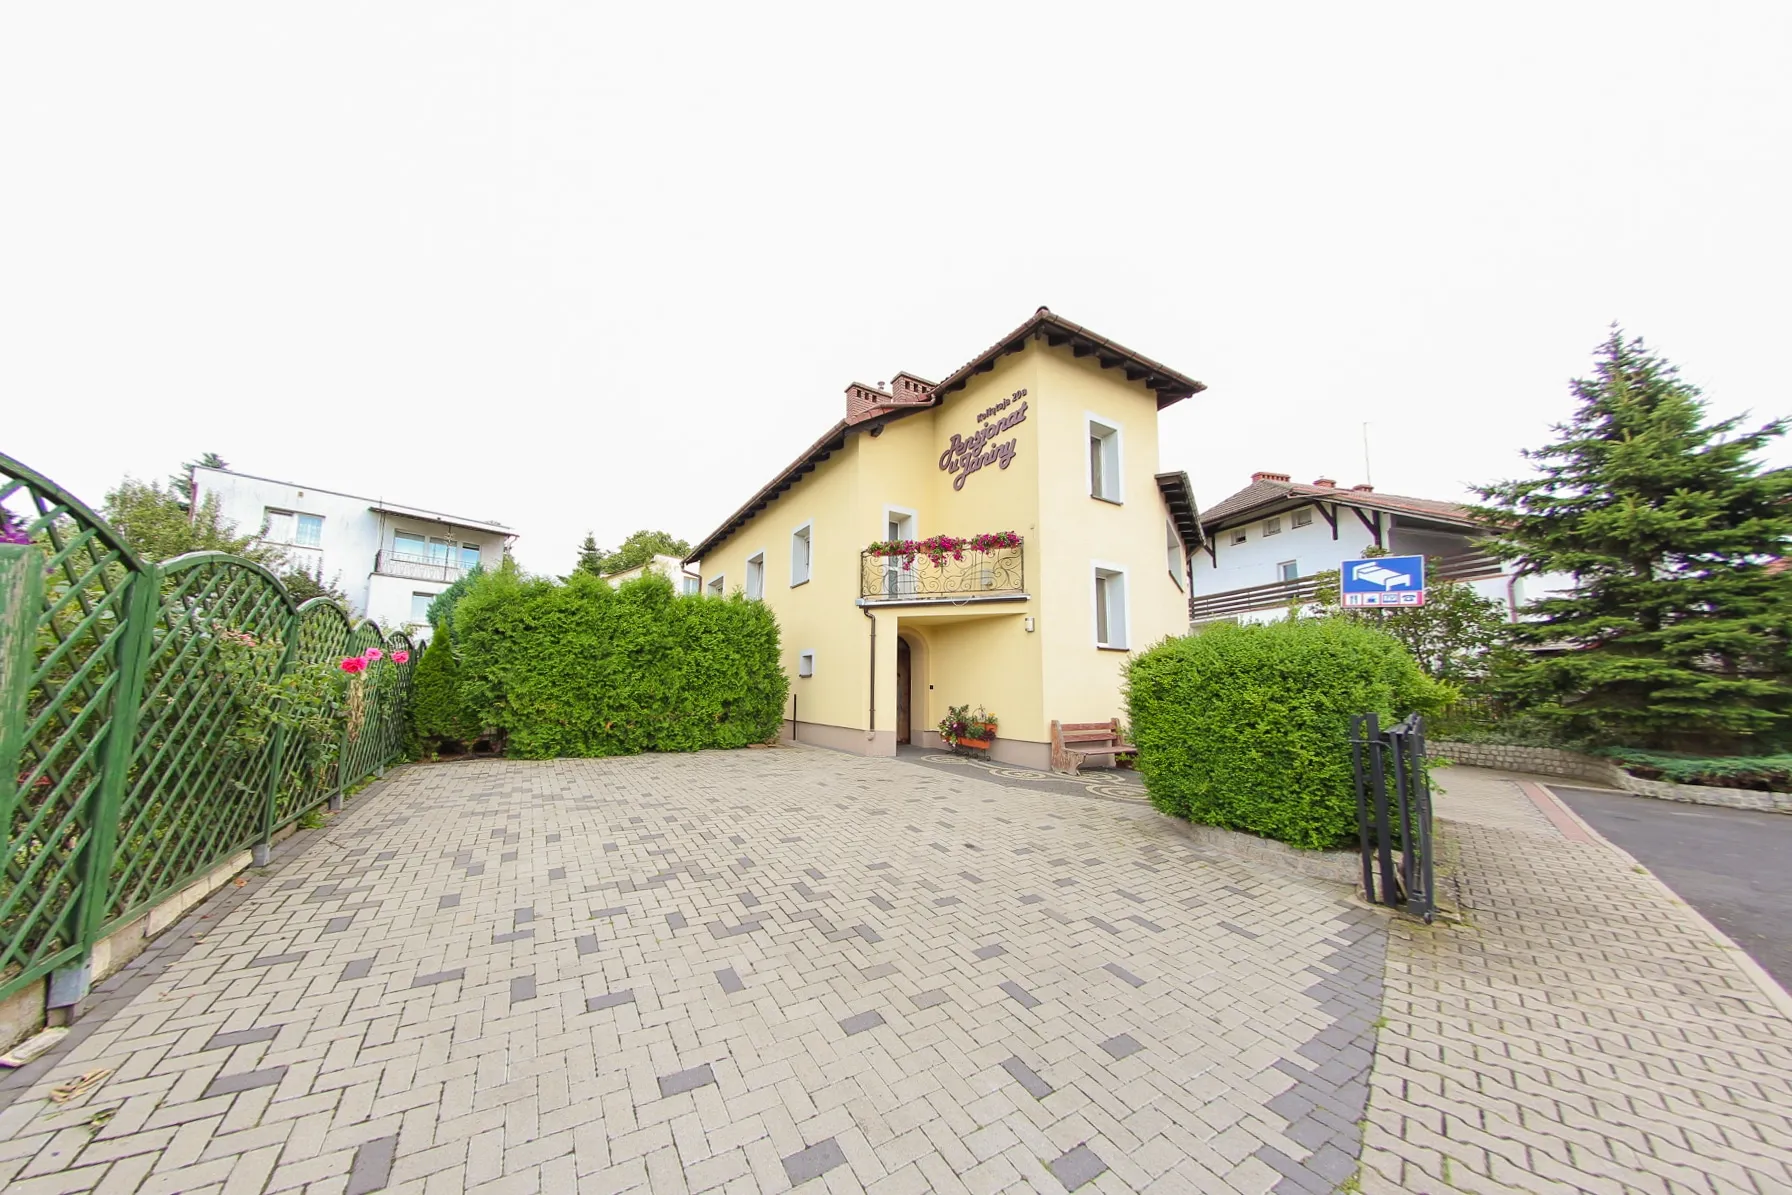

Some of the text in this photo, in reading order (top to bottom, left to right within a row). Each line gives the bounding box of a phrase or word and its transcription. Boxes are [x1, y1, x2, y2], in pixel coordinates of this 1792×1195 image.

[939, 401, 1028, 471] Pensjonat
[948, 438, 1017, 491] u Janiny
